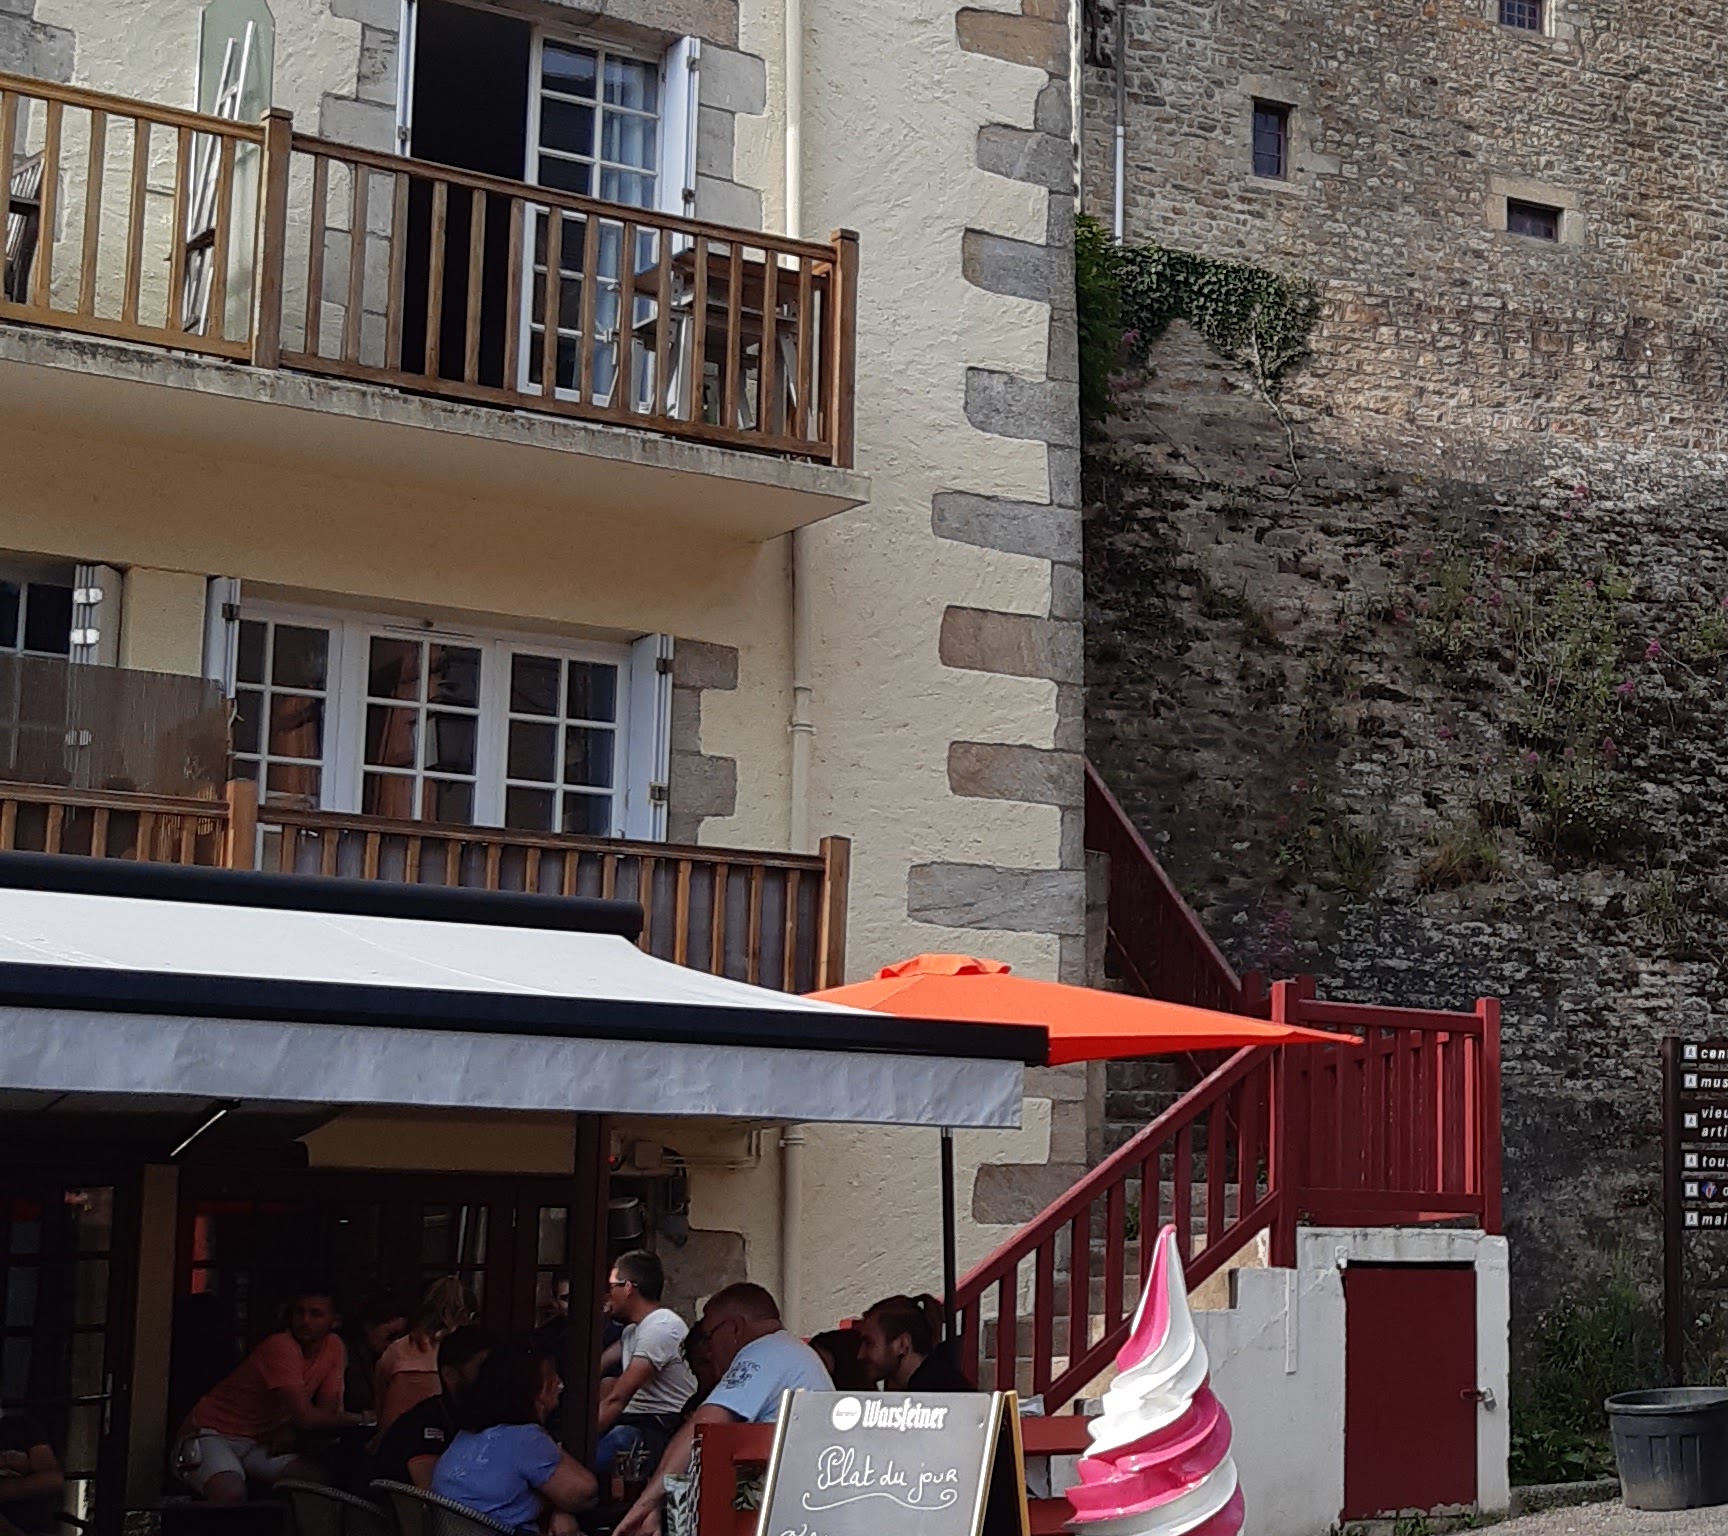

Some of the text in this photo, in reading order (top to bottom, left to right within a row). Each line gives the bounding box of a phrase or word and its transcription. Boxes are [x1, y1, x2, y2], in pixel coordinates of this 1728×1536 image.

[862, 1397, 948, 1432] Warsteiner
[817, 1445, 876, 1490] Plat
[880, 1461, 907, 1485] du
